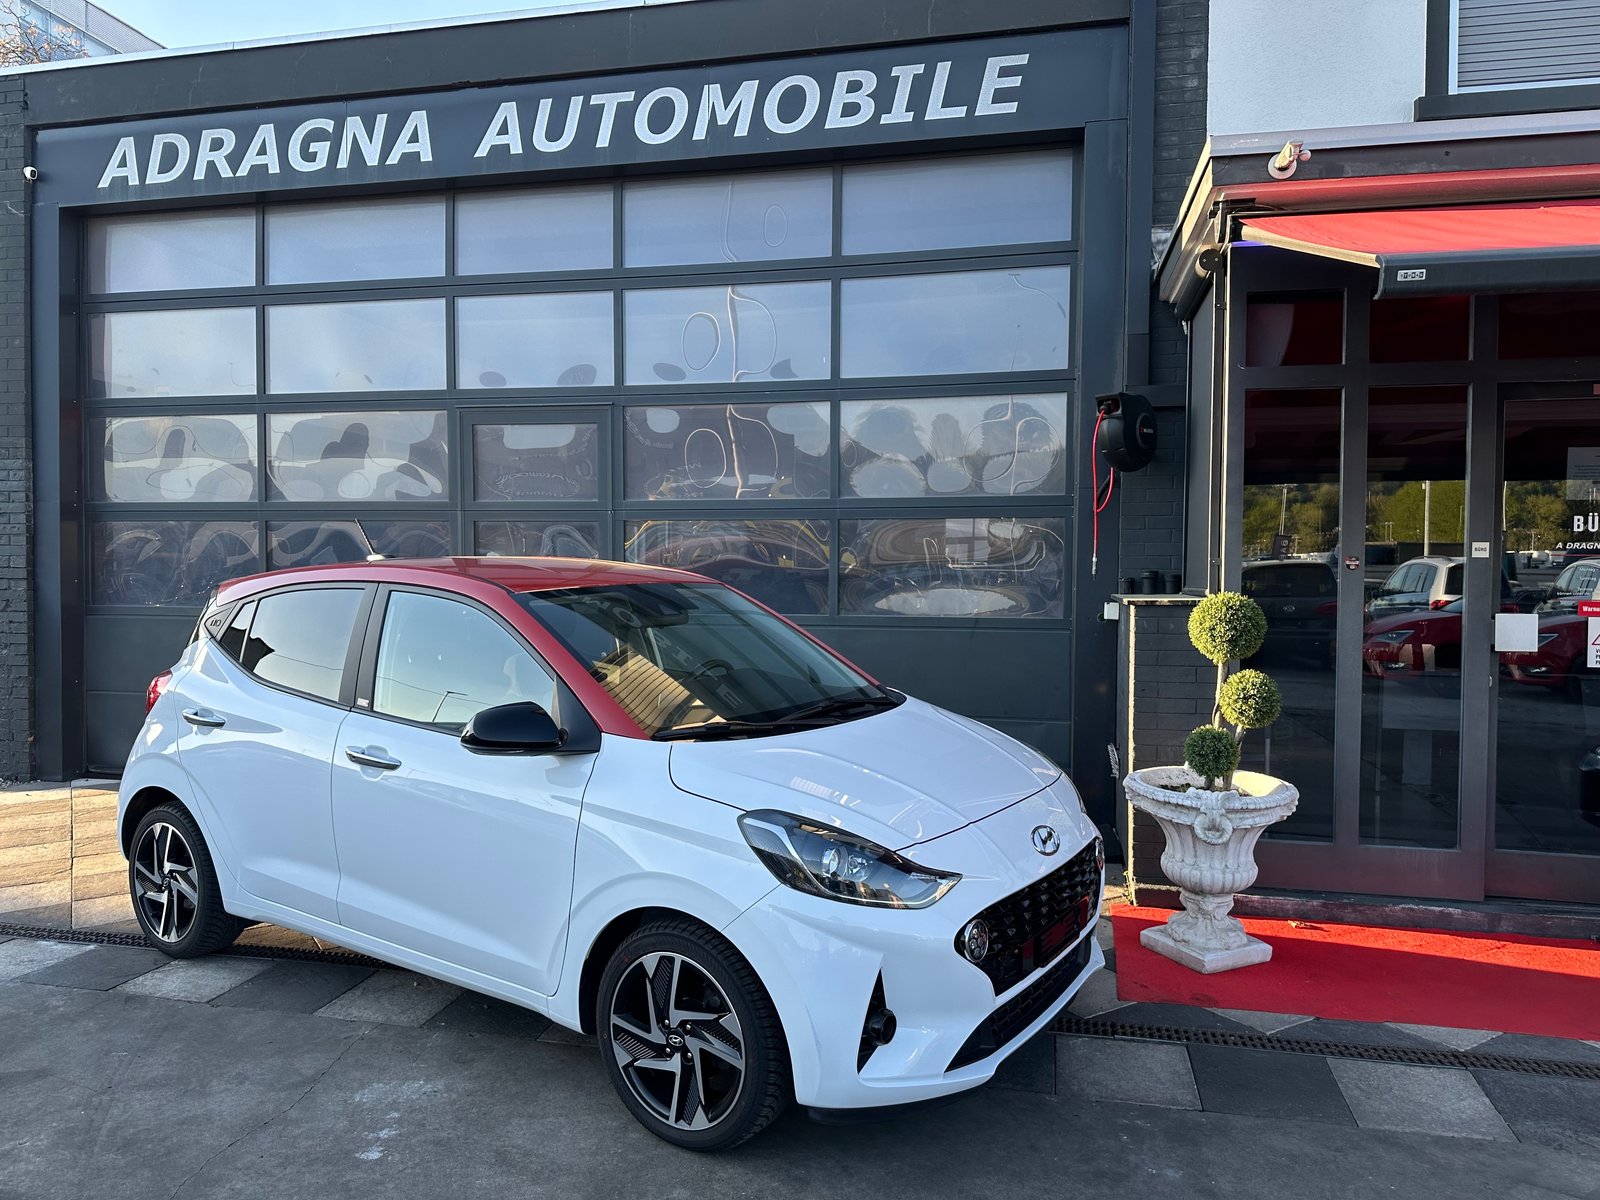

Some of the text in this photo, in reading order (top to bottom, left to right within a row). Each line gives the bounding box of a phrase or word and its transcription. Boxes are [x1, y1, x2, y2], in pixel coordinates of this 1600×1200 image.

[97, 52, 1030, 189] ADRAGNA AUTOMOBILE
[210, 616, 222, 628] i10
